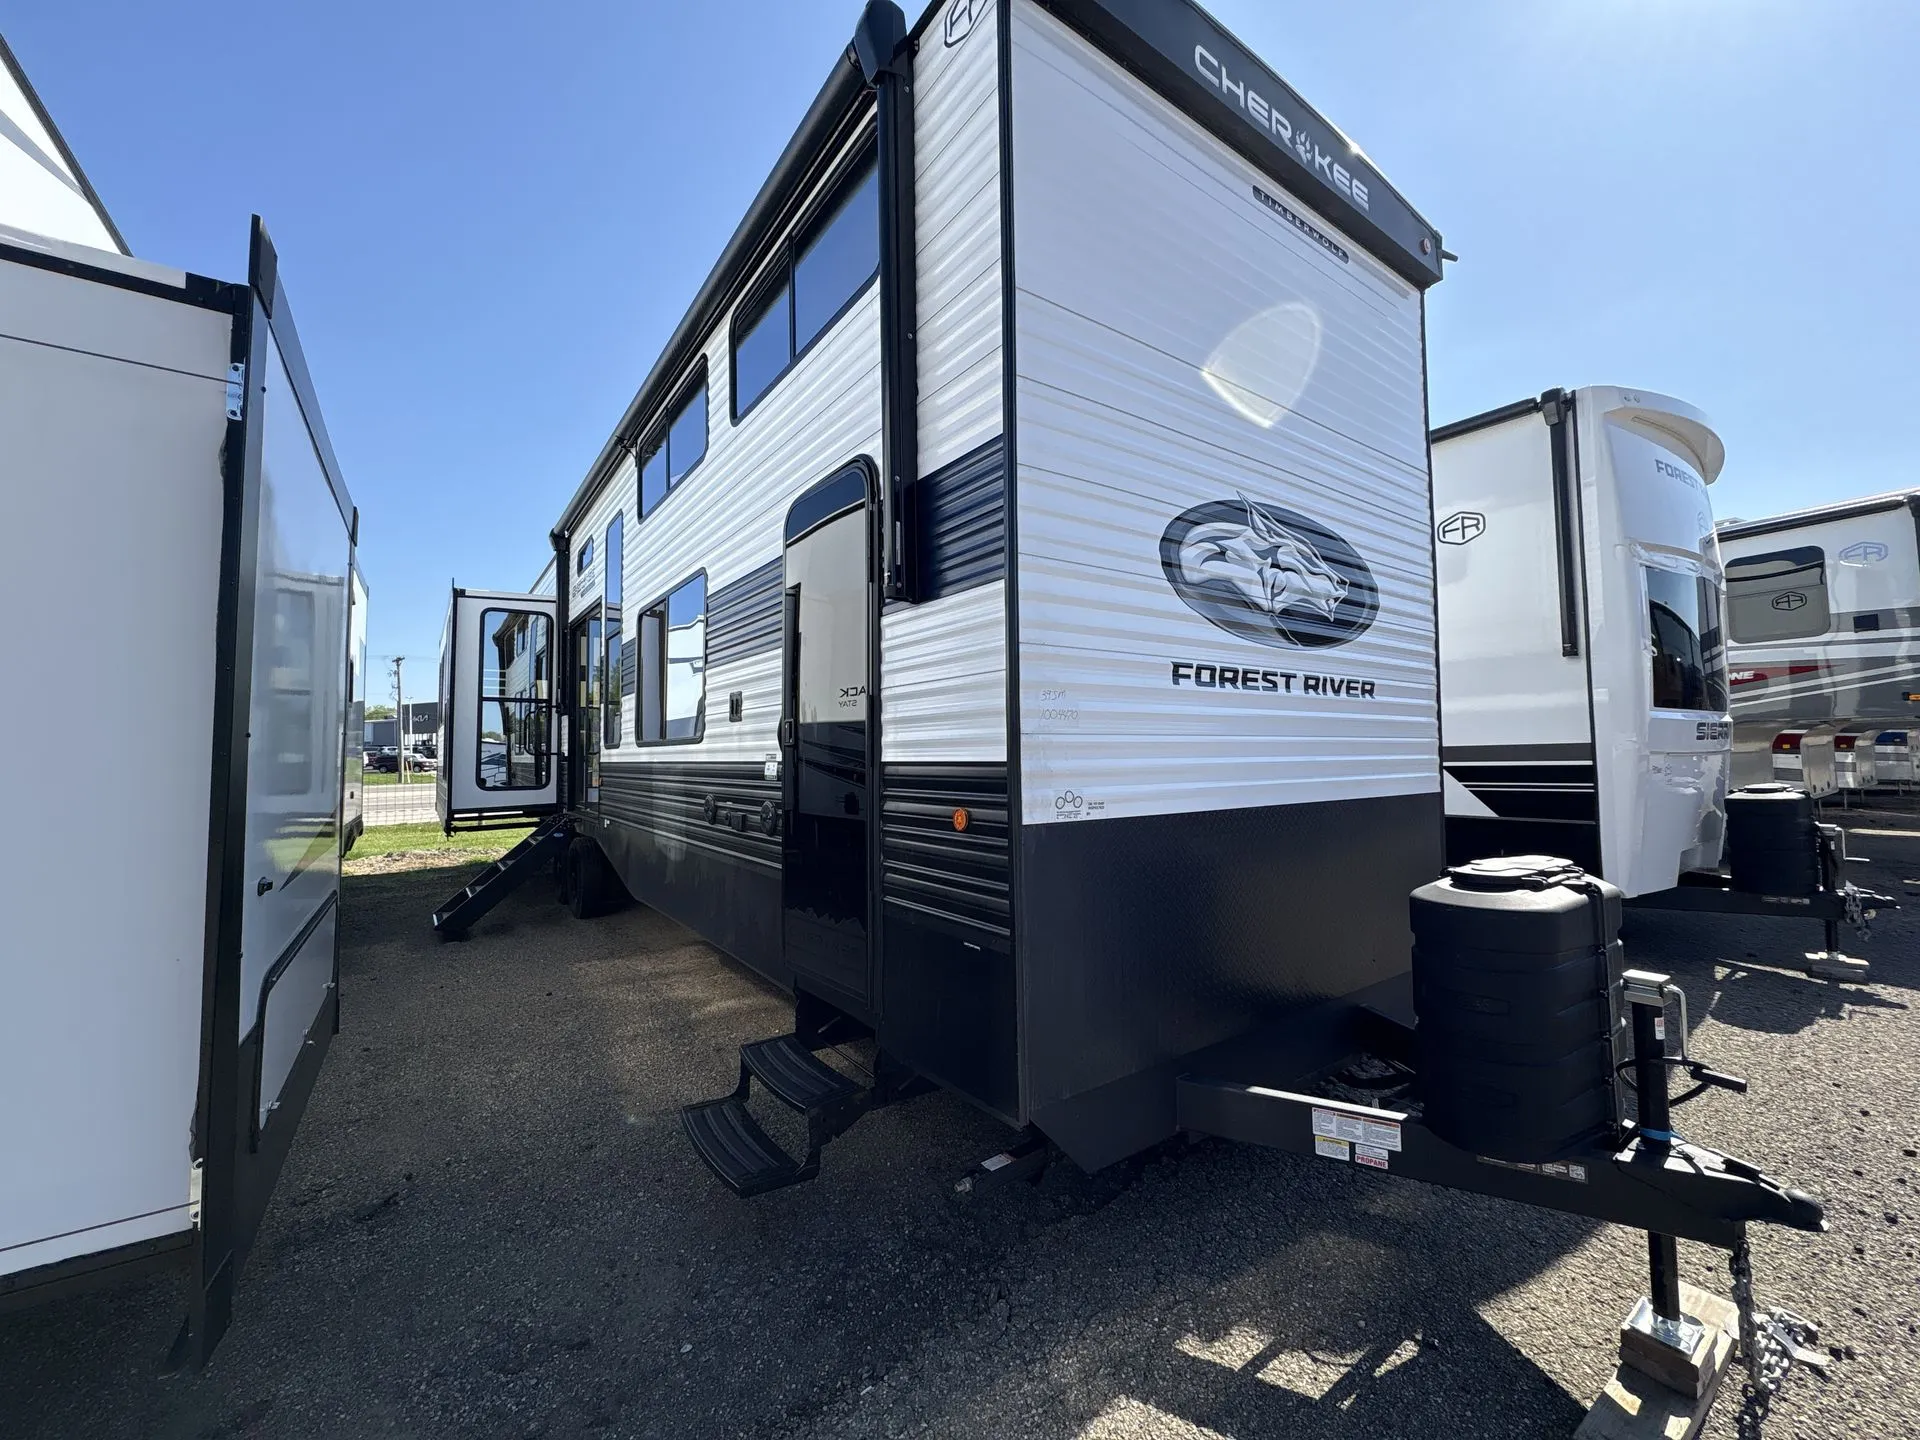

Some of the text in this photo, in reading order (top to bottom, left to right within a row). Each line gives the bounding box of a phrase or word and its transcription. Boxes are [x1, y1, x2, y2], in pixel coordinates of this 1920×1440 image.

[1260, 192, 1344, 257] TIMBERWOLF
[1654, 458, 1699, 491] FOREST
[1170, 660, 1376, 700] FOREST RIVER
[1356, 1155, 1387, 1168] PROPANE
